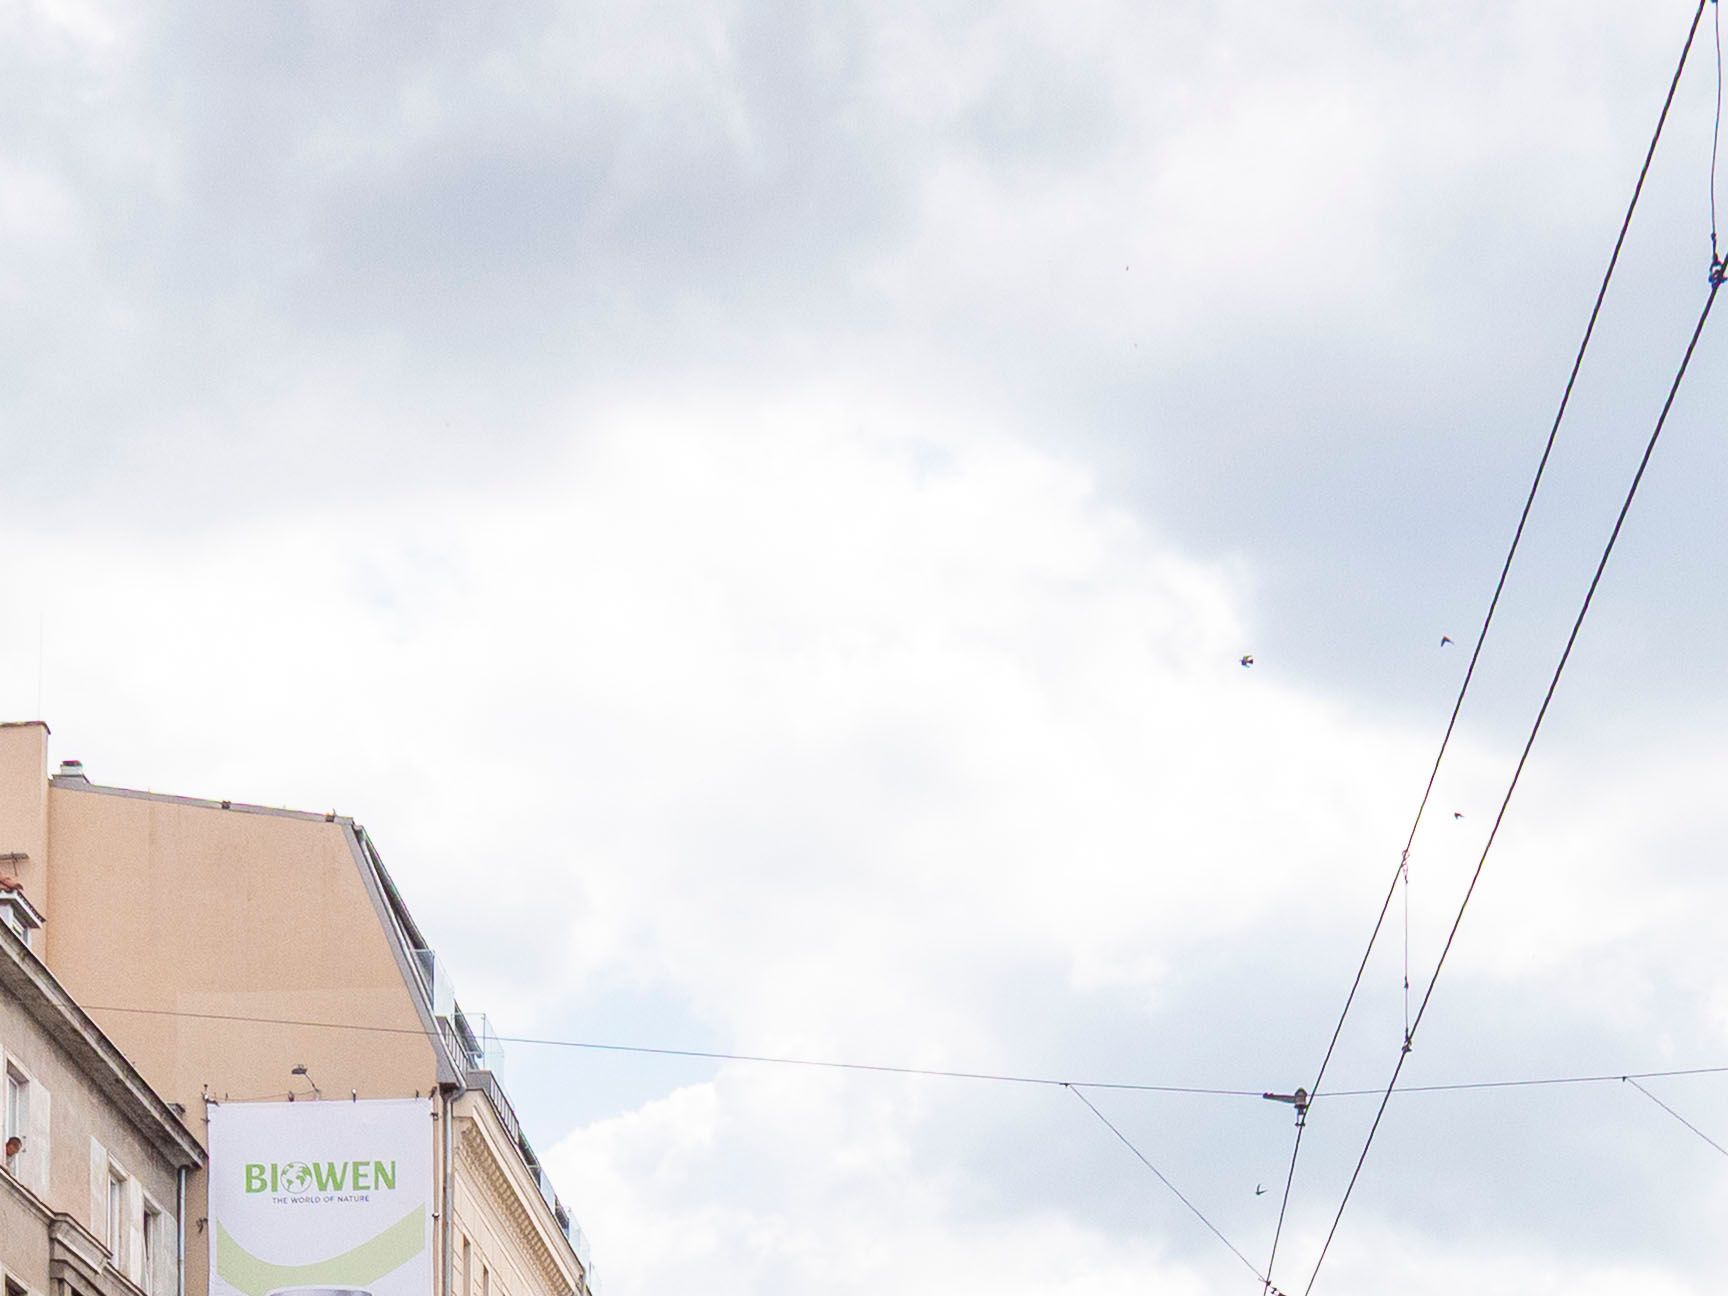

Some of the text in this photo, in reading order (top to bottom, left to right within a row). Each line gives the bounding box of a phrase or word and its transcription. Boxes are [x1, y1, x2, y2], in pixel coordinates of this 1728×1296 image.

[245, 1161, 396, 1194] BIOWEN
[273, 1194, 370, 1205] THE WORLD OF NATURE
